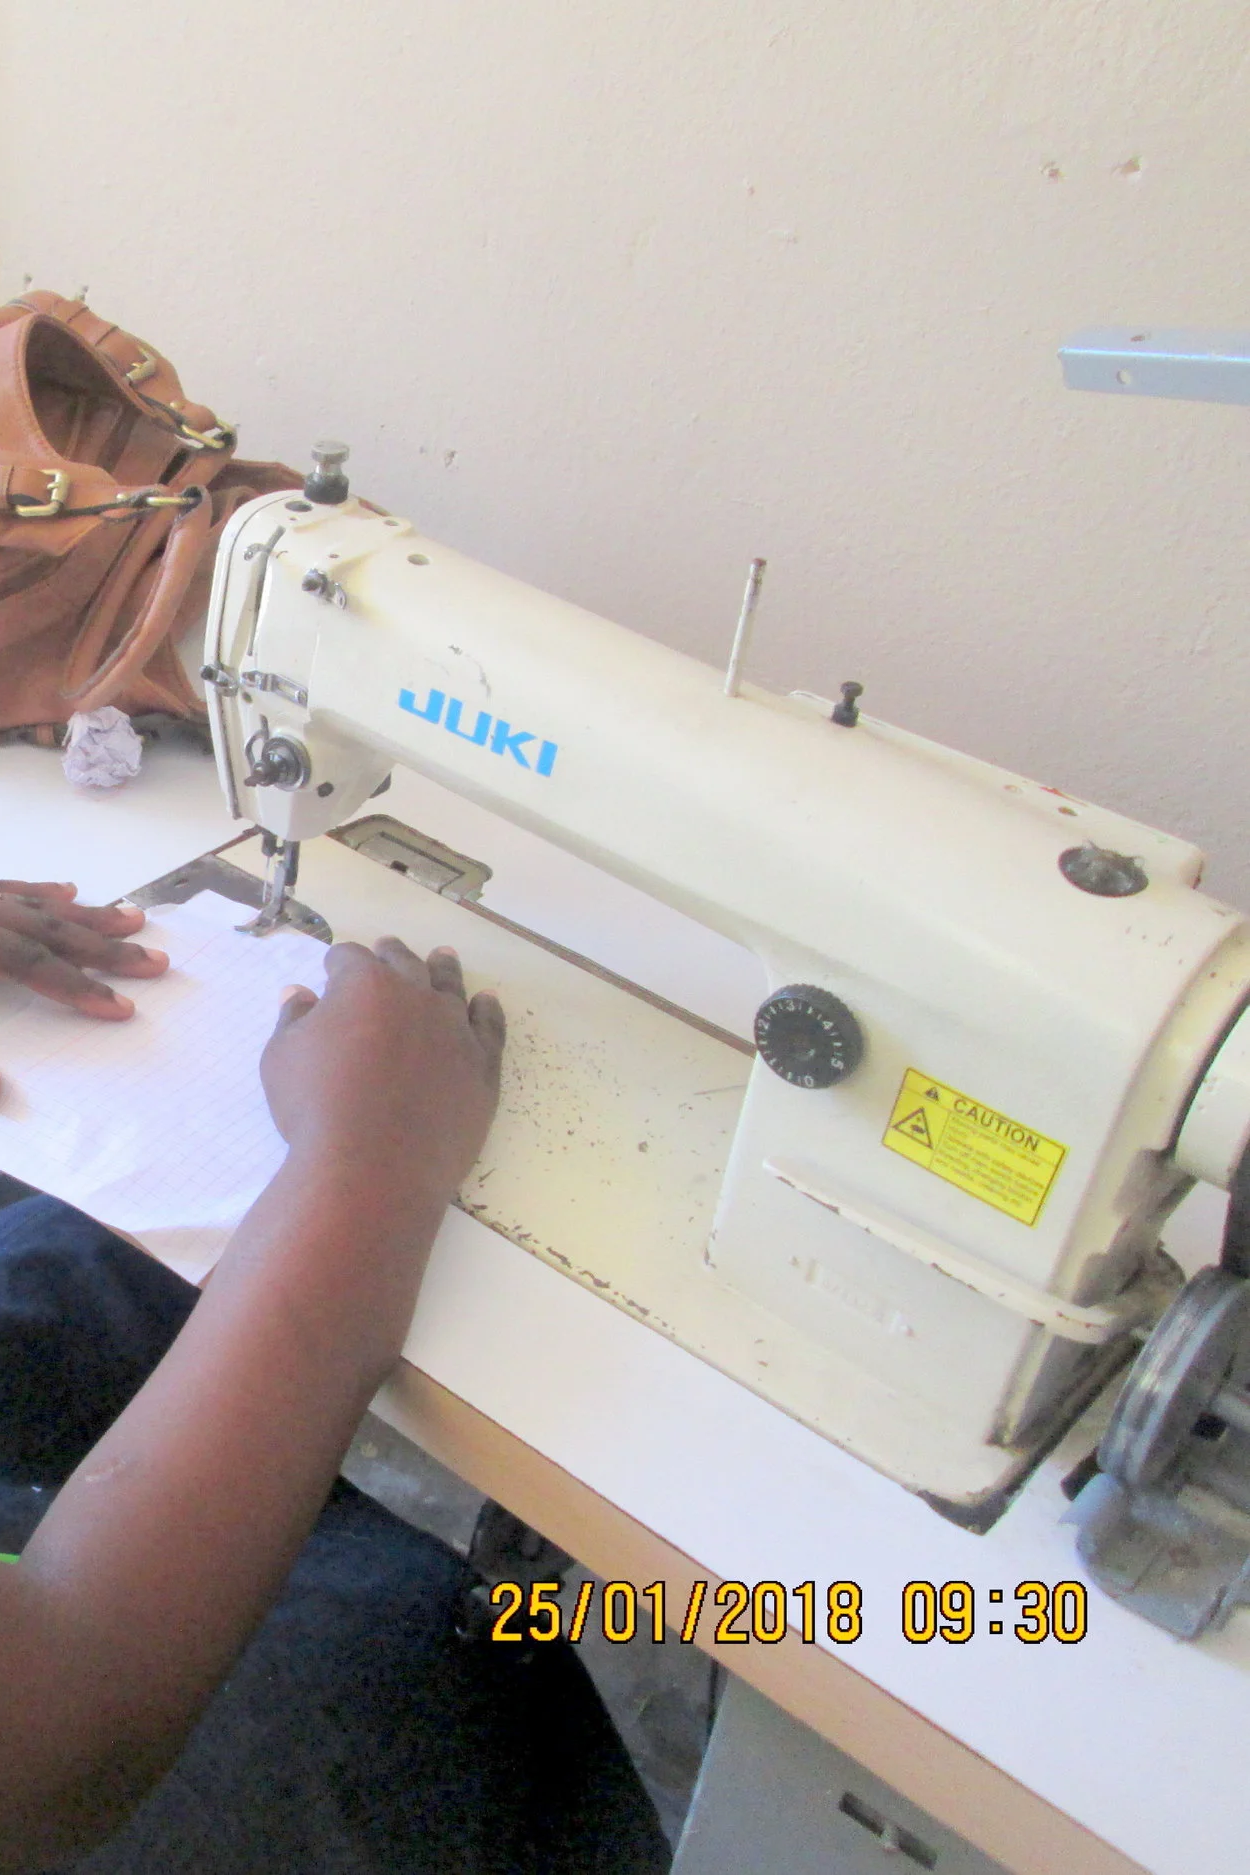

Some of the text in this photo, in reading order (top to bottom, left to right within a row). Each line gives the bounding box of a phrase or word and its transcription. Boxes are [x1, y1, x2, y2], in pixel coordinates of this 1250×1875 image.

[398, 688, 558, 777] JUKI
[786, 1000, 796, 1012] 3
[758, 1019, 770, 1030] 2
[823, 1020, 834, 1031] 4
[831, 1058, 844, 1070] 5
[803, 1075, 814, 1088] 0
[953, 1099, 1039, 1152] CAUTION
